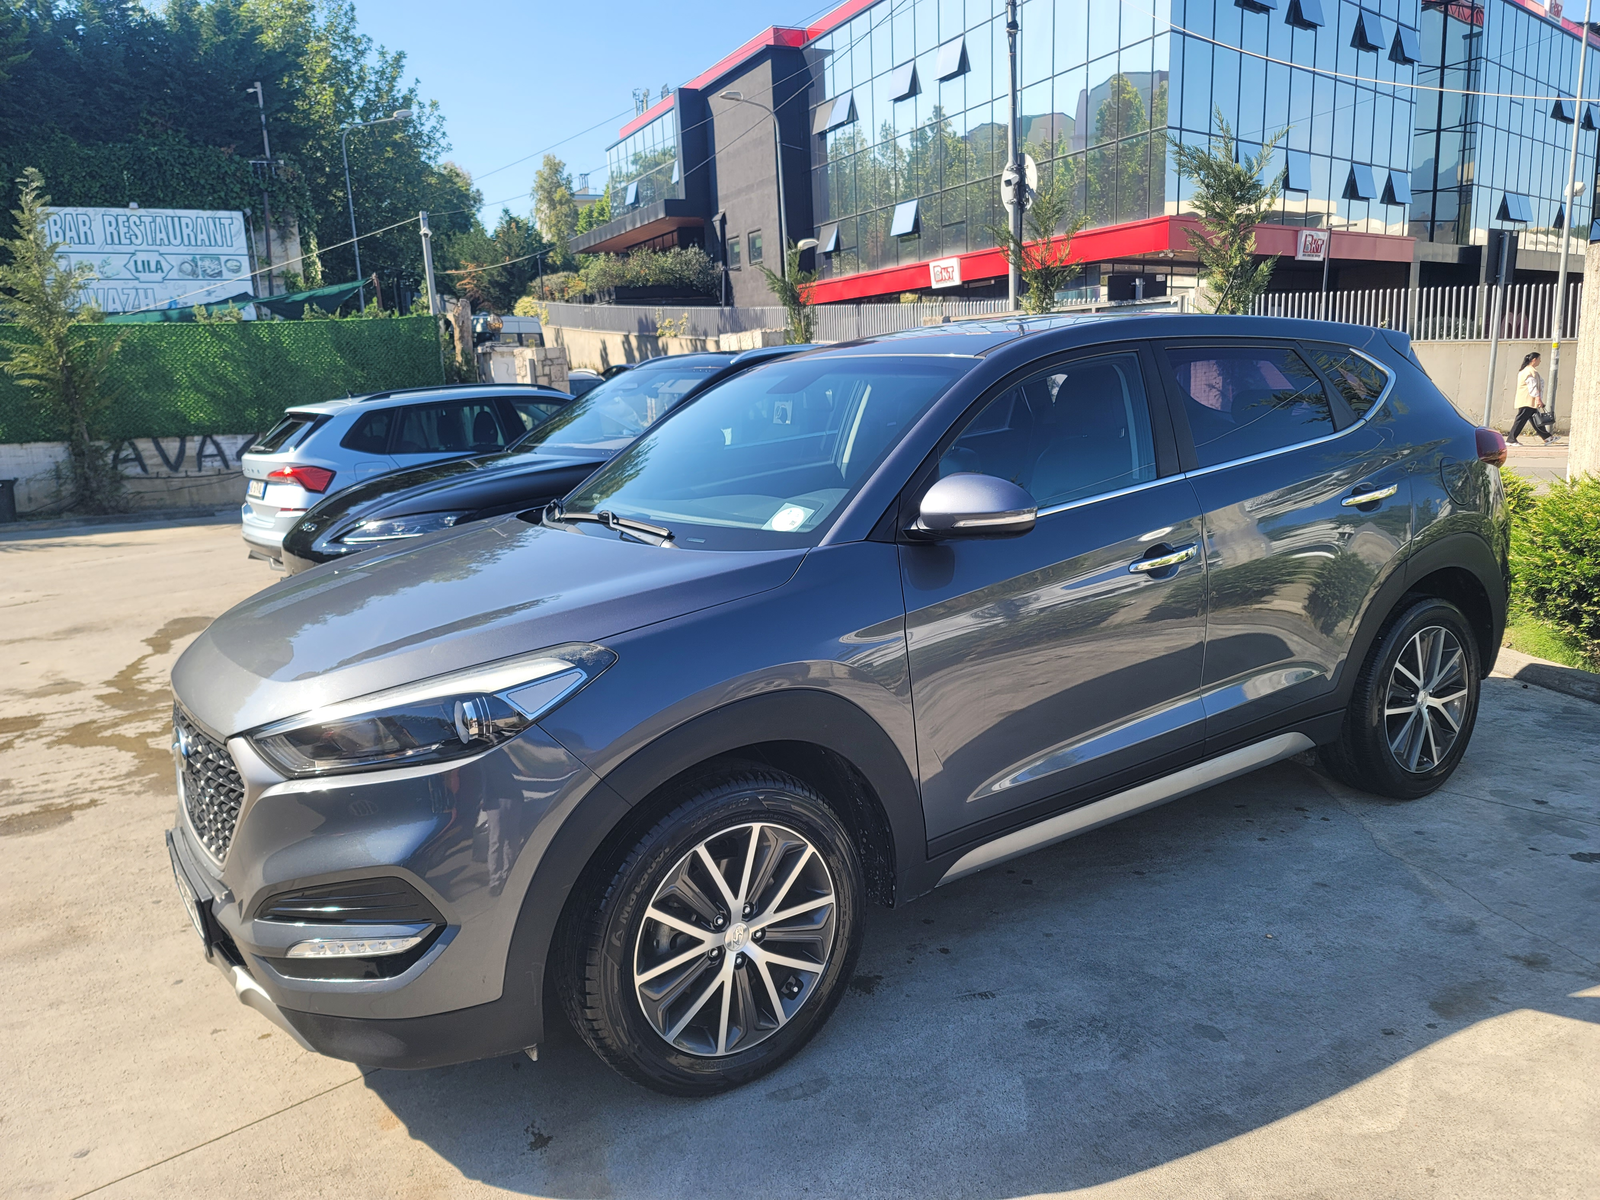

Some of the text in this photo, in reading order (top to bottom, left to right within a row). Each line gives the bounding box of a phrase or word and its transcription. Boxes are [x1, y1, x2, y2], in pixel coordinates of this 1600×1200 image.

[49, 213, 234, 247] BAR RESTAURANT
[134, 259, 164, 274] LILA
